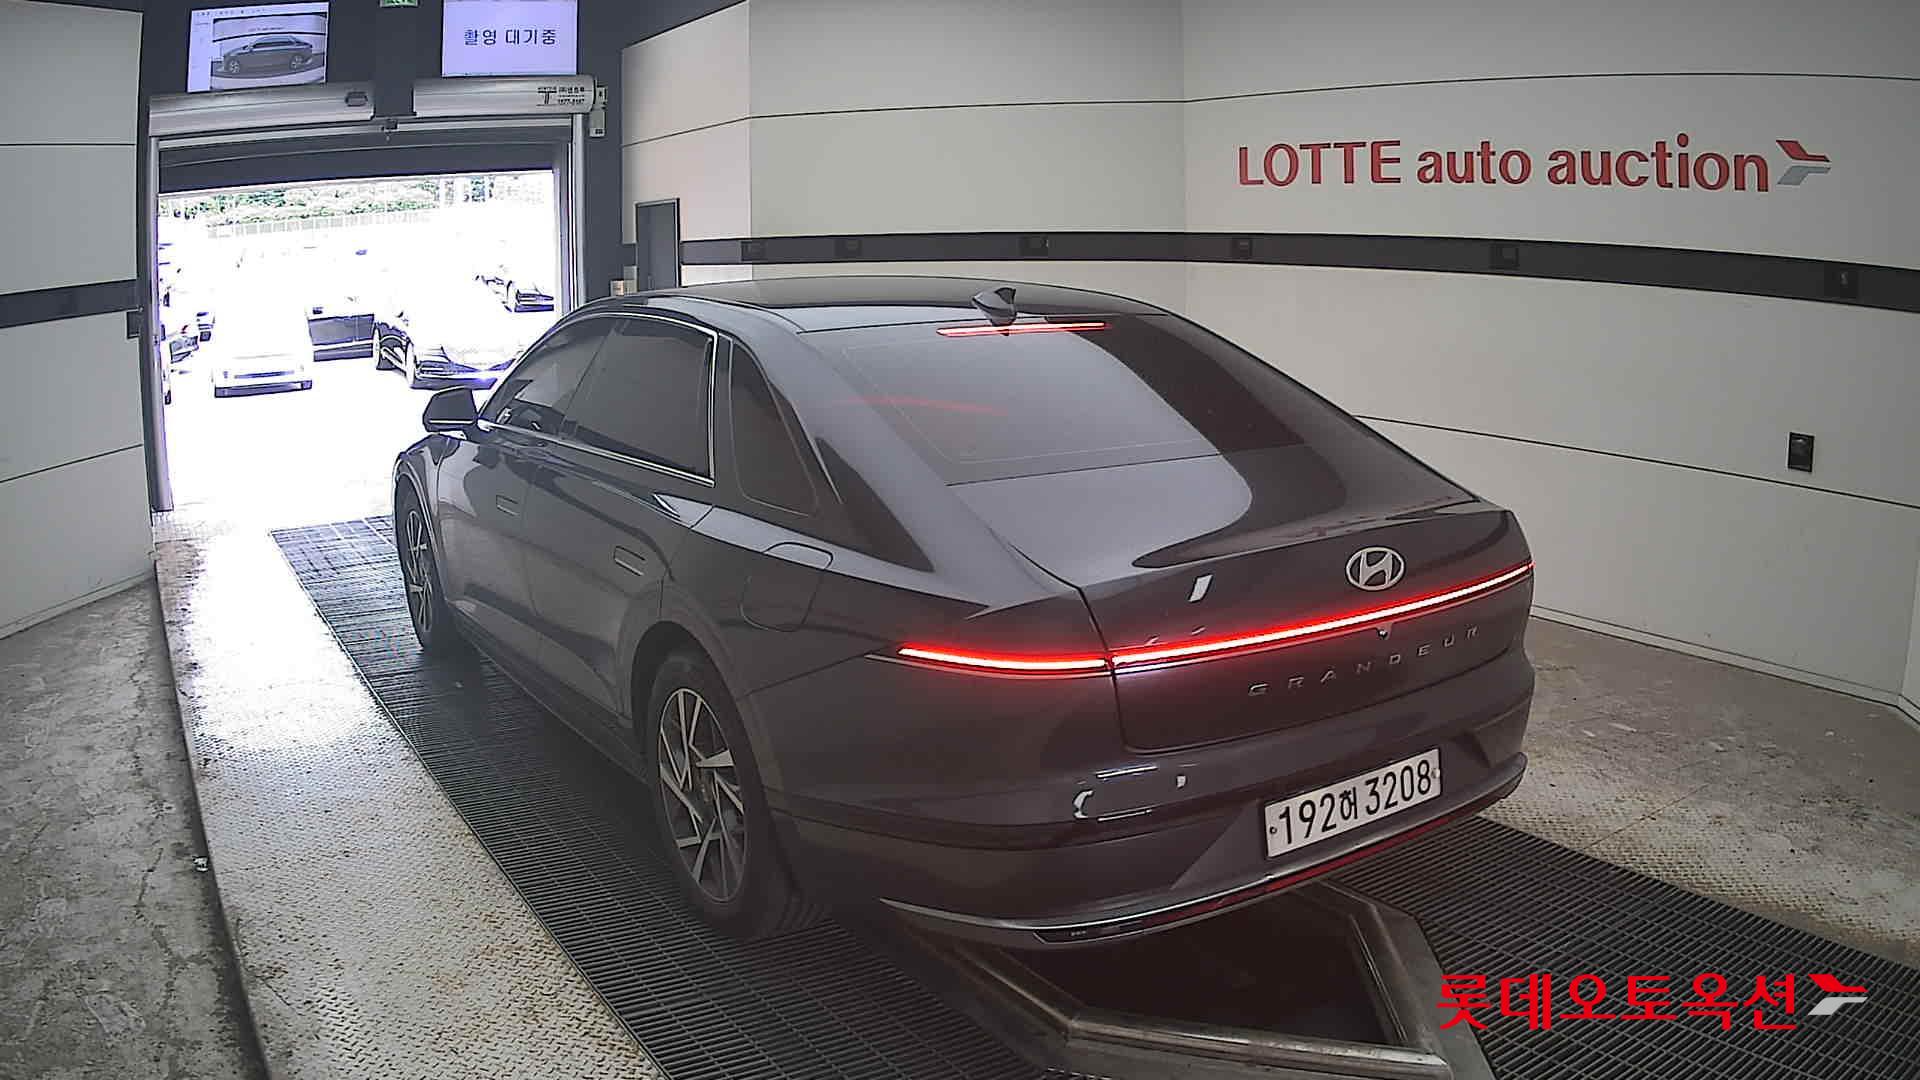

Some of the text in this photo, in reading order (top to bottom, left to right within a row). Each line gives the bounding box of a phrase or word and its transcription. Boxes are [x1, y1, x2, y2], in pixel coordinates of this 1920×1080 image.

[463, 28, 557, 47] 촬영 대기중
[1238, 133, 1770, 193] LOTTE auto auction
[1249, 625, 1478, 696] GRANDEUR
[1364, 759, 1432, 815] 3208
